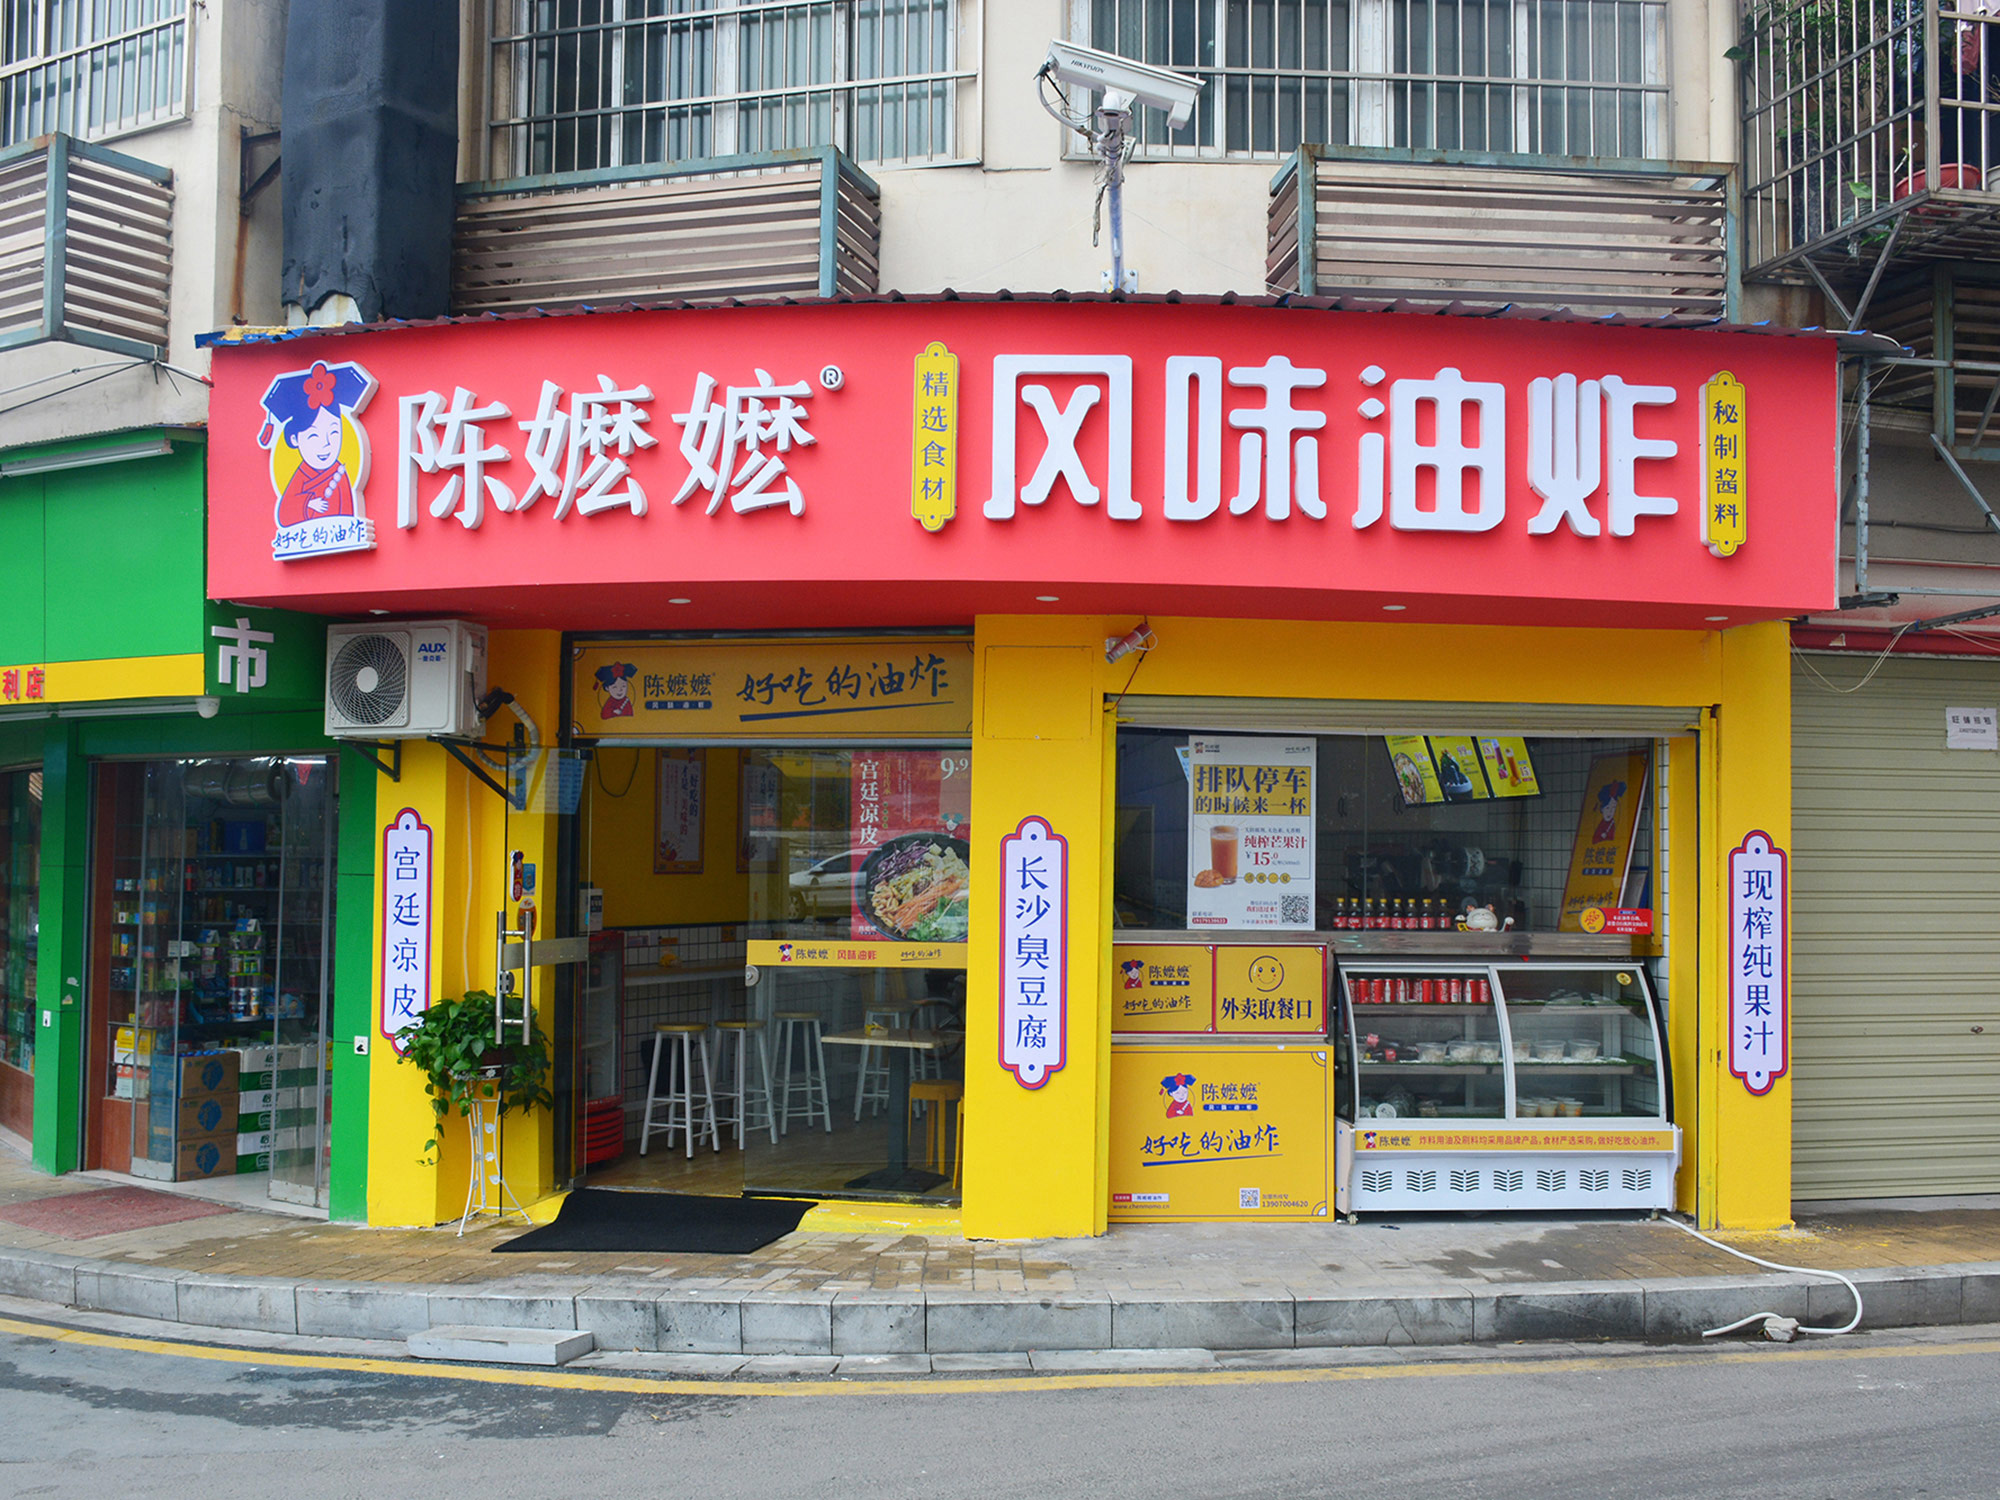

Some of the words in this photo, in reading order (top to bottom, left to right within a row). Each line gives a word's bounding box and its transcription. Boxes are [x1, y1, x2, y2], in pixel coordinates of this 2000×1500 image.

[397, 368, 818, 530] 陈嬷嬷
[920, 370, 949, 501] 精选食材
[983, 353, 1680, 538] 风味油炸
[1712, 399, 1740, 528] 秘制酱料
[273, 519, 365, 549] 好吃的油炸
[211, 617, 274, 693] 市
[417, 642, 447, 653] AUX
[2, 666, 45, 700] 利店
[643, 672, 713, 699] 陈嬷嬷
[736, 653, 950, 706] 好吃的油炸
[1197, 766, 1308, 794] 排队停车
[860, 759, 880, 846] 宫廷凉皮
[1196, 796, 1307, 815] 的时候来一杯
[1244, 835, 1308, 849] 纯榨芒果汁
[392, 846, 421, 1019] 宫廷凉皮
[837, 949, 877, 960] 风味油炸
[1015, 856, 1051, 1049] 长沙臭豆腐
[1742, 869, 1774, 1055] 现榨纯果汁
[1149, 965, 1190, 978] 陈嬷嬷
[1123, 995, 1192, 1012] 好吃的油炸
[1221, 997, 1312, 1020] 外卖取餐口
[1201, 1083, 1258, 1101] 陈嬷嬷
[1140, 1124, 1280, 1157] 好吃的油炸
